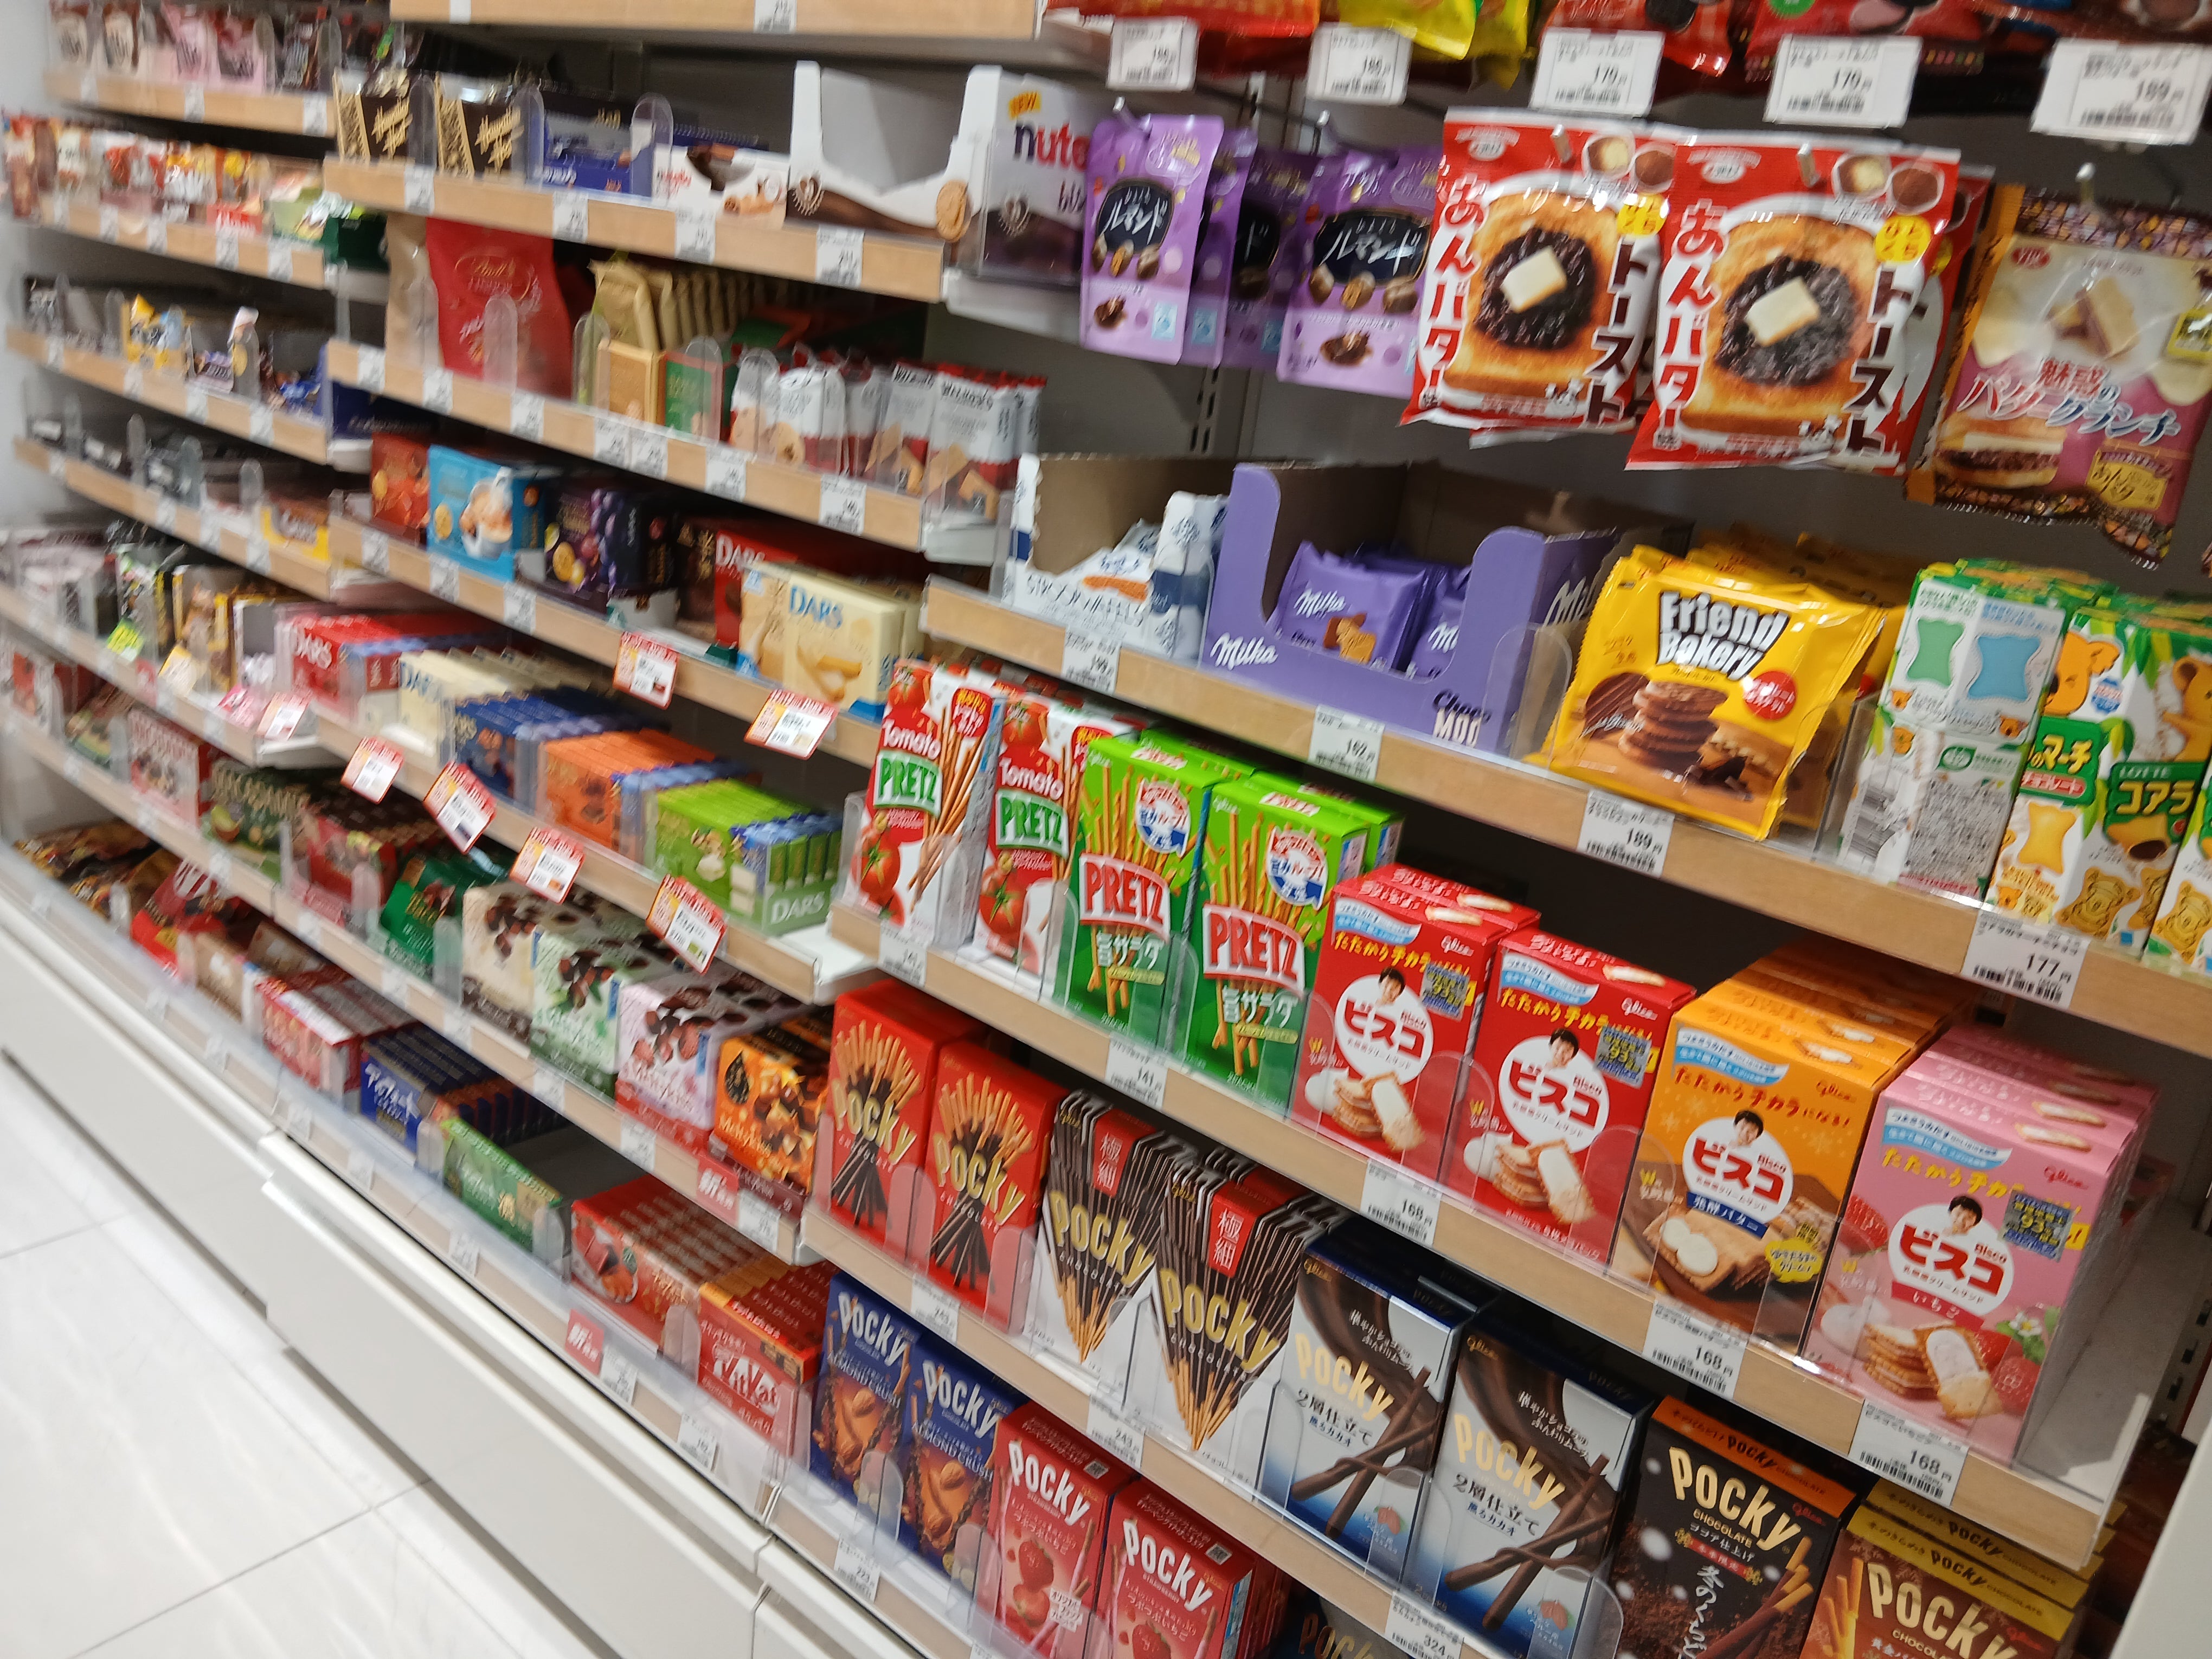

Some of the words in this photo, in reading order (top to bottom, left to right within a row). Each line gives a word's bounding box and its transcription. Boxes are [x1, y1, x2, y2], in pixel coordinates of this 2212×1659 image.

[1584, 236, 1651, 426] トースト
[1660, 200, 1726, 428] あんバター
[1842, 266, 1914, 454] トースト
[1294, 587, 1346, 619] Milka
[1657, 591, 1791, 652] Friend
[1210, 632, 1278, 670] Milka
[1655, 628, 1765, 681] Bakery
[883, 718, 942, 760] Tomato
[879, 758, 938, 806] PRETZ
[999, 757, 1064, 801] Tomato
[2117, 781, 2195, 814] コアラ
[1000, 798, 1066, 847] PRETZ
[773, 892, 826, 925] DARS
[1085, 861, 1165, 928] PRETZ
[1209, 912, 1300, 983] PRETZ
[1344, 998, 1427, 1063] ビスコ
[1508, 1058, 1600, 1130] ビスコ
[1096, 1132, 1122, 1193] 極細
[1691, 1135, 1785, 1205] ビスコ
[1212, 1207, 1245, 1271] 極細
[1900, 1224, 2005, 1297] ビスコ
[1693, 1508, 1753, 1548] CHOCOLATE
